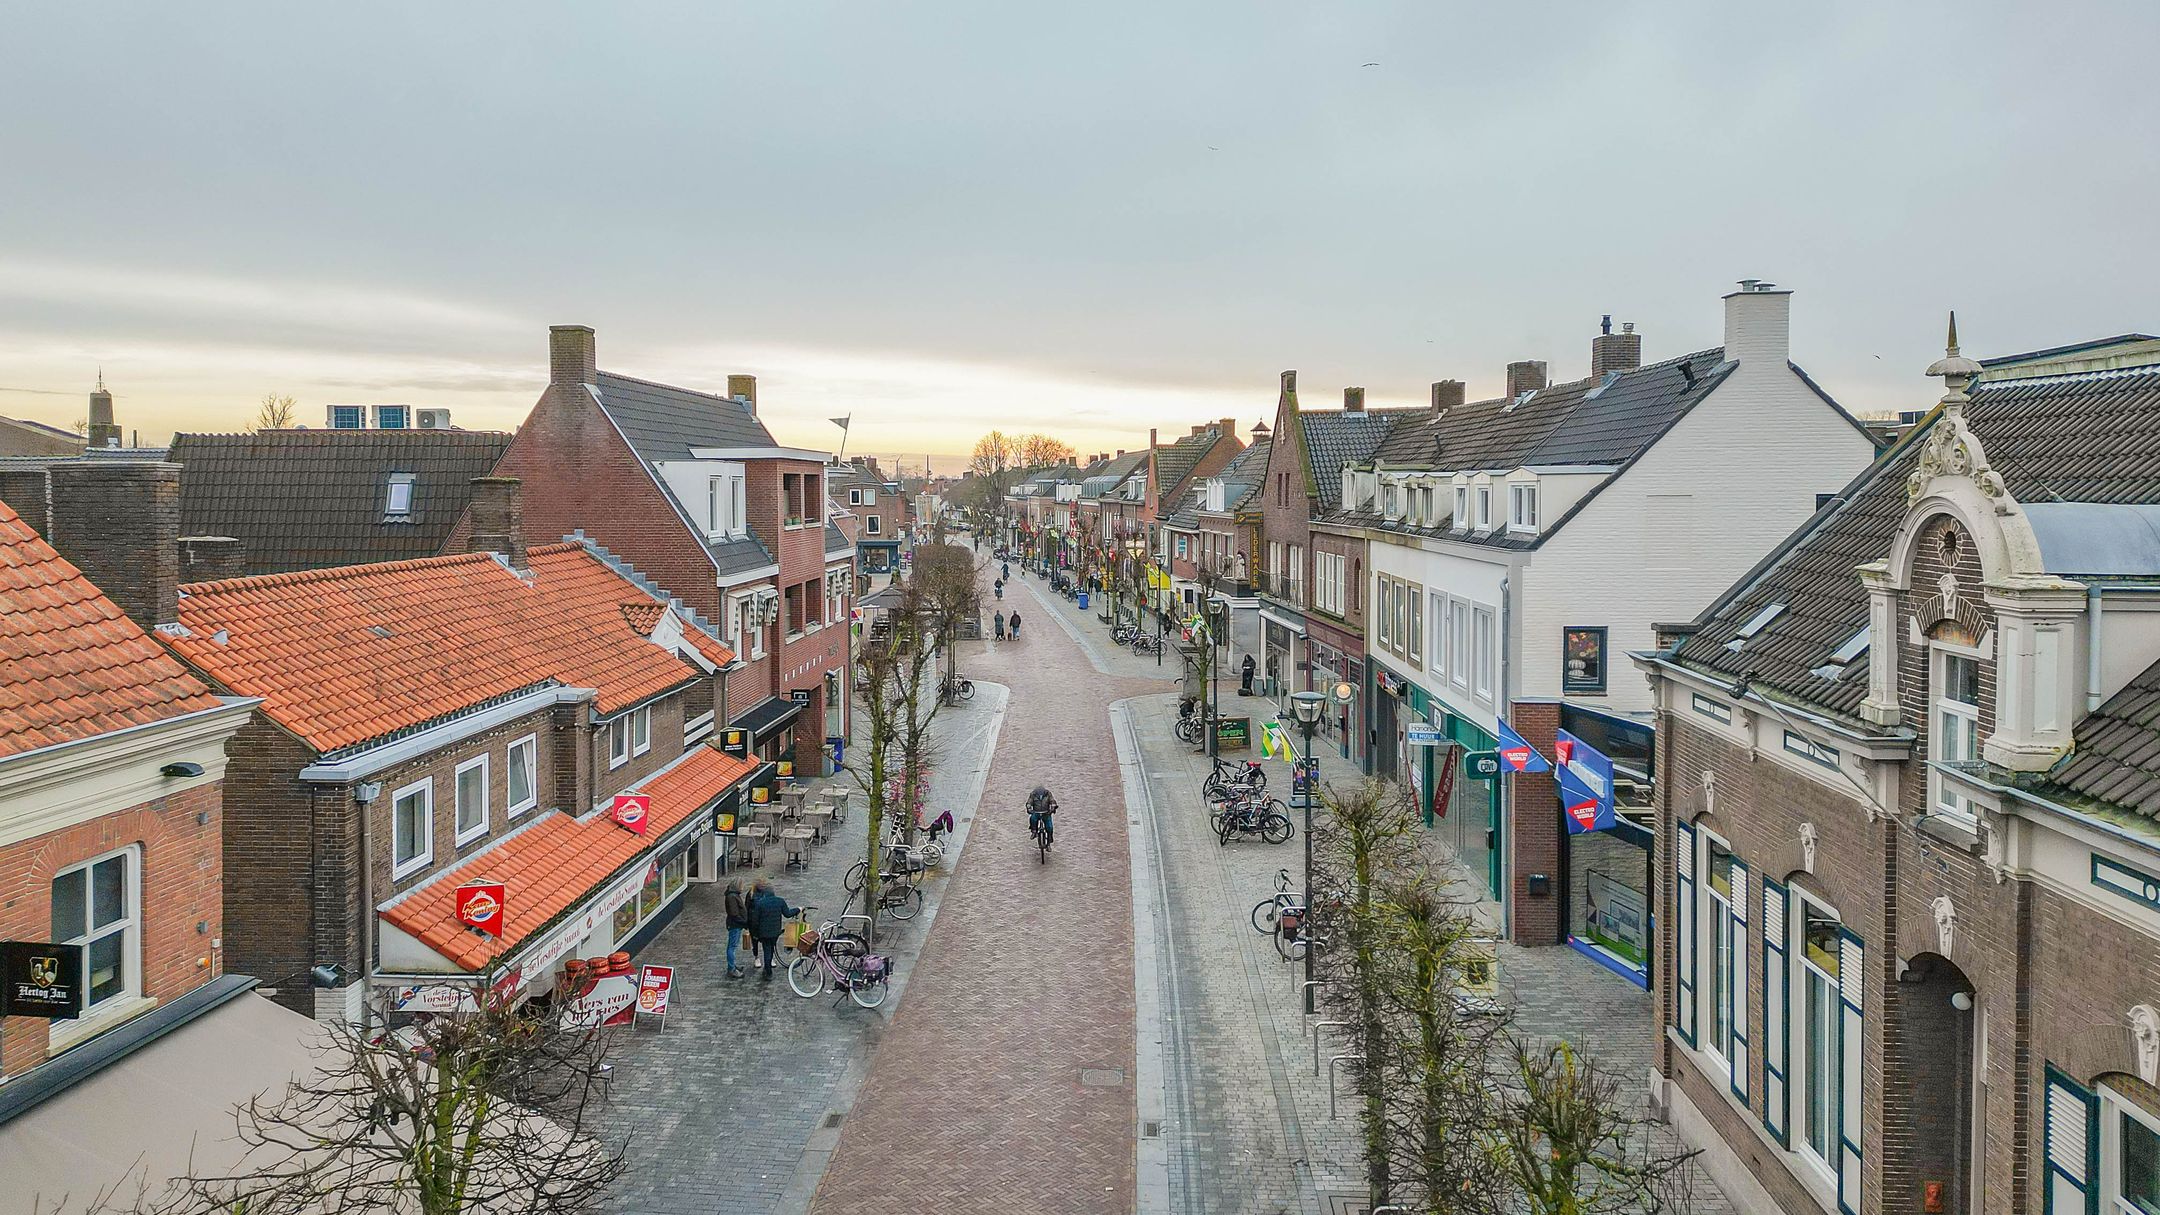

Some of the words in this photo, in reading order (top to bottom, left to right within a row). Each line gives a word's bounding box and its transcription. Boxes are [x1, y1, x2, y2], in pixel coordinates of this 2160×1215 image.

[1573, 807, 1595, 815] ELECTRO
[1576, 812, 1594, 820] WORLD
[18, 986, 49, 998] Hertog
[49, 988, 67, 1000] Jan
